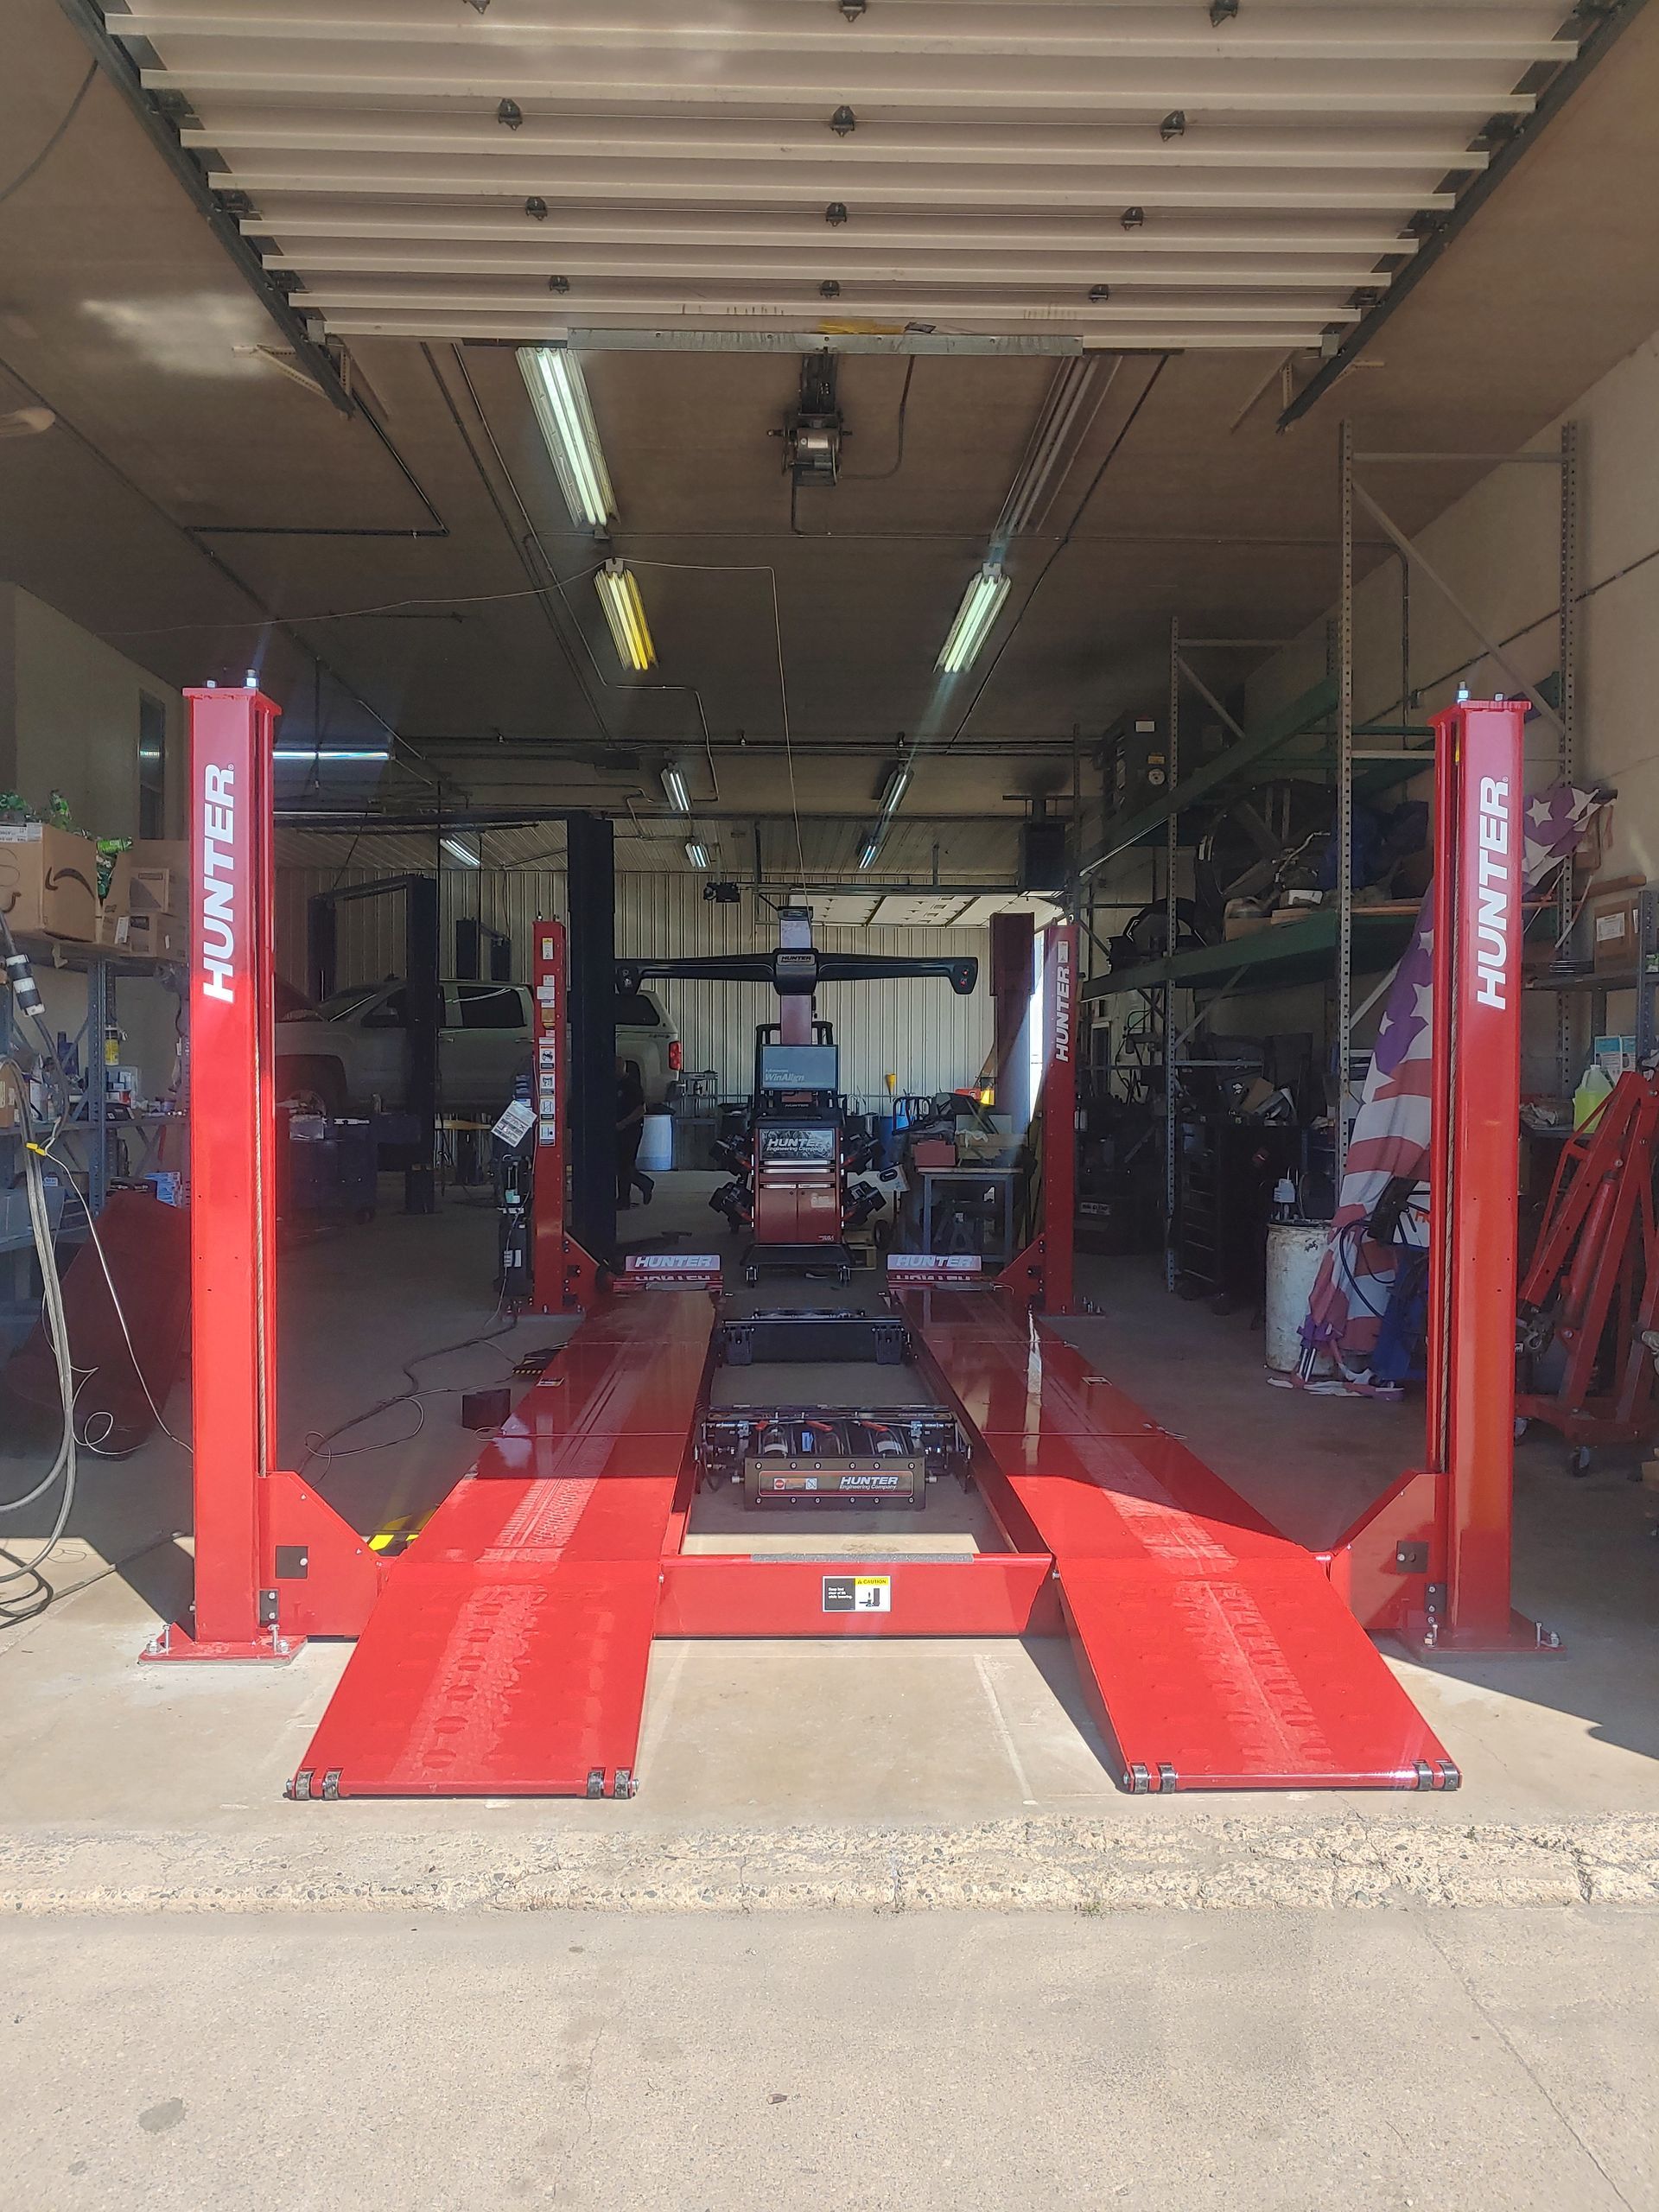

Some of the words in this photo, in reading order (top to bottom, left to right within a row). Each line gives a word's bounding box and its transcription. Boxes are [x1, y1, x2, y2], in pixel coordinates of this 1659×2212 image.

[202, 764, 234, 1003] HUNTER
[1477, 776, 1509, 1010] HUNTER
[1055, 966, 1070, 1063] HUNTER
[634, 1255, 714, 1268] HUNTER
[896, 1255, 973, 1268] HUNTER
[841, 1476, 899, 1485] HUNTER
